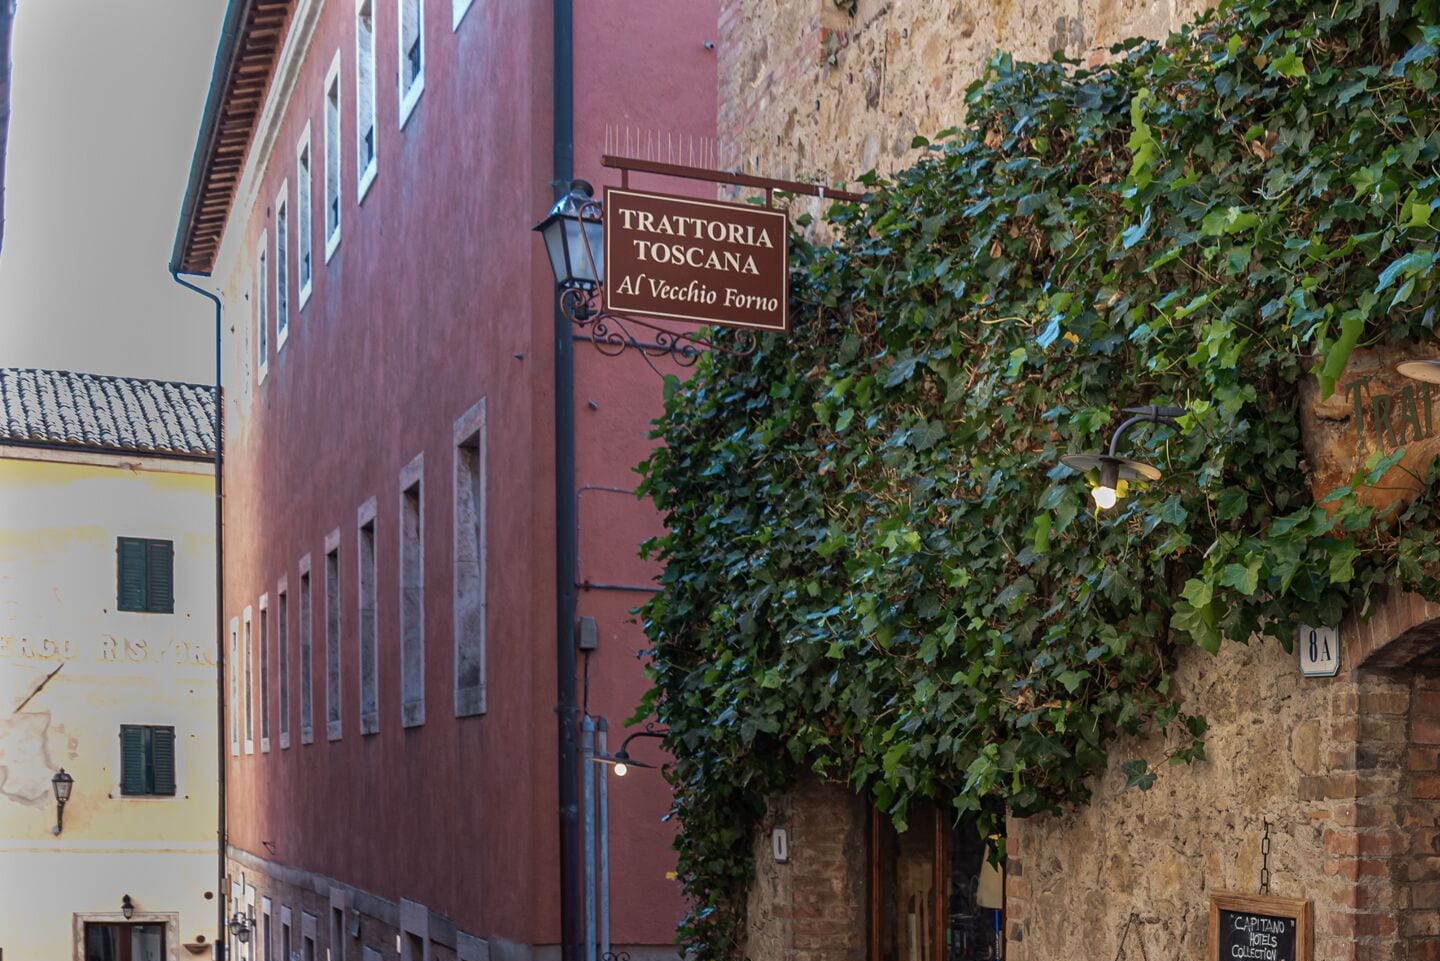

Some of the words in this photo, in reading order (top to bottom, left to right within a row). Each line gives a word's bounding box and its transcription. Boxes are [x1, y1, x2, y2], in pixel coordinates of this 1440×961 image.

[618, 208, 774, 249] TRATTORIA
[633, 239, 760, 275] TOSCANA
[616, 273, 645, 296] Al
[648, 277, 717, 305] Vecchio
[723, 287, 778, 313] Forno
[1309, 630, 1332, 663] 8A
[1249, 932, 1278, 948] HOTELS
